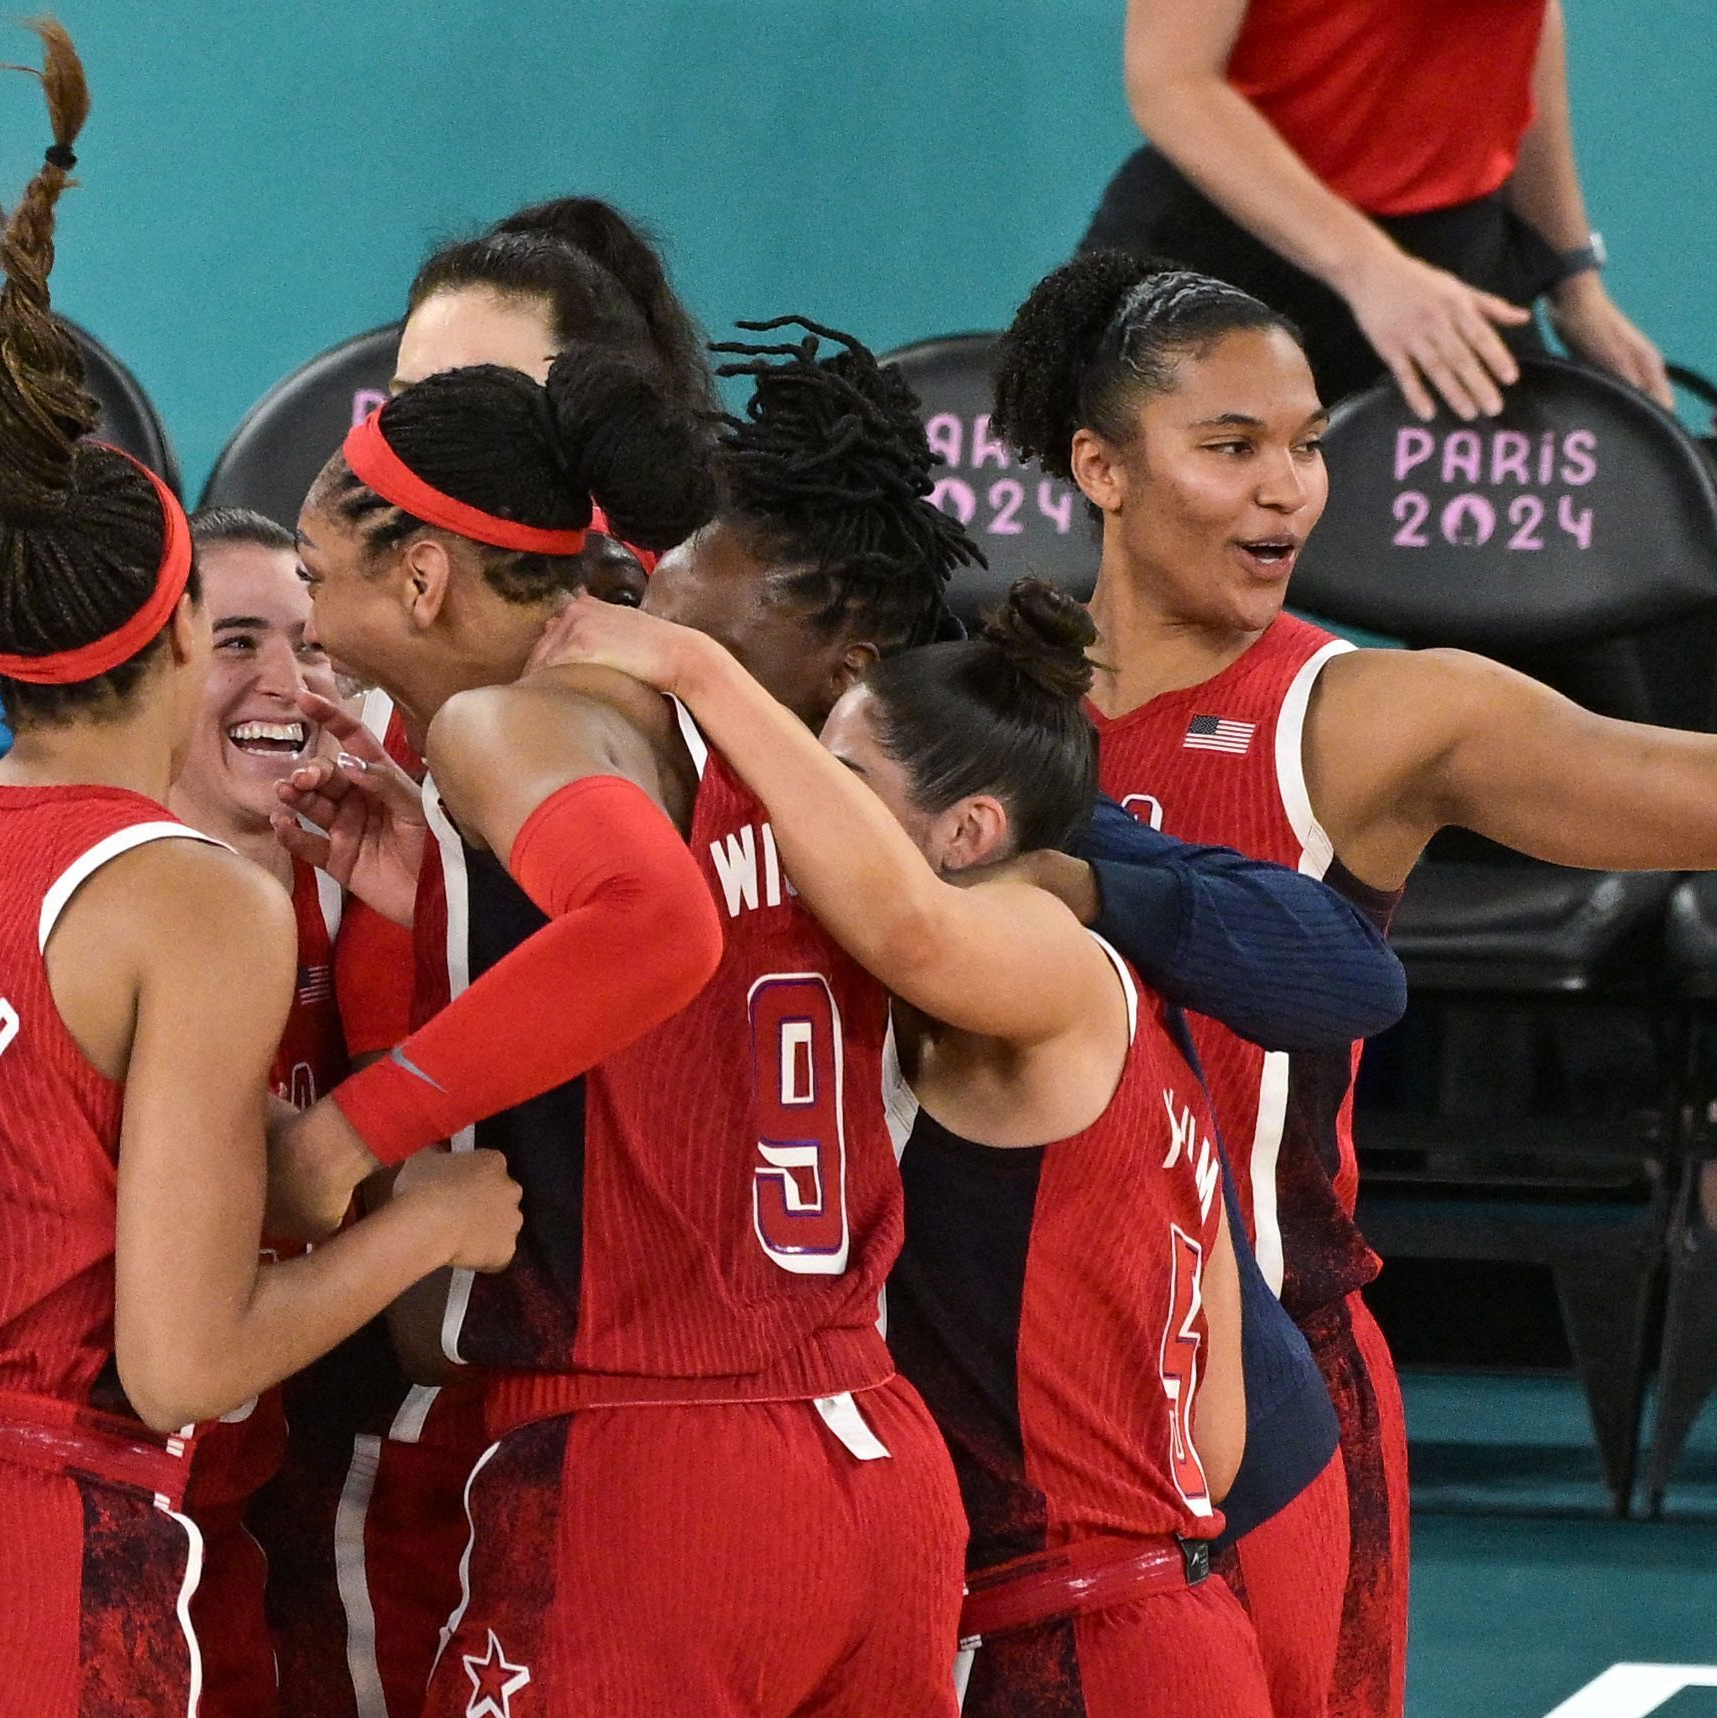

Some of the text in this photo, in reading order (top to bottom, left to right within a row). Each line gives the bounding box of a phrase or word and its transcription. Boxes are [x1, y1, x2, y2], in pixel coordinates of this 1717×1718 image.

[1392, 491, 1593, 551] 2024
[709, 822, 798, 918] WI
[746, 972, 850, 1275] 9
